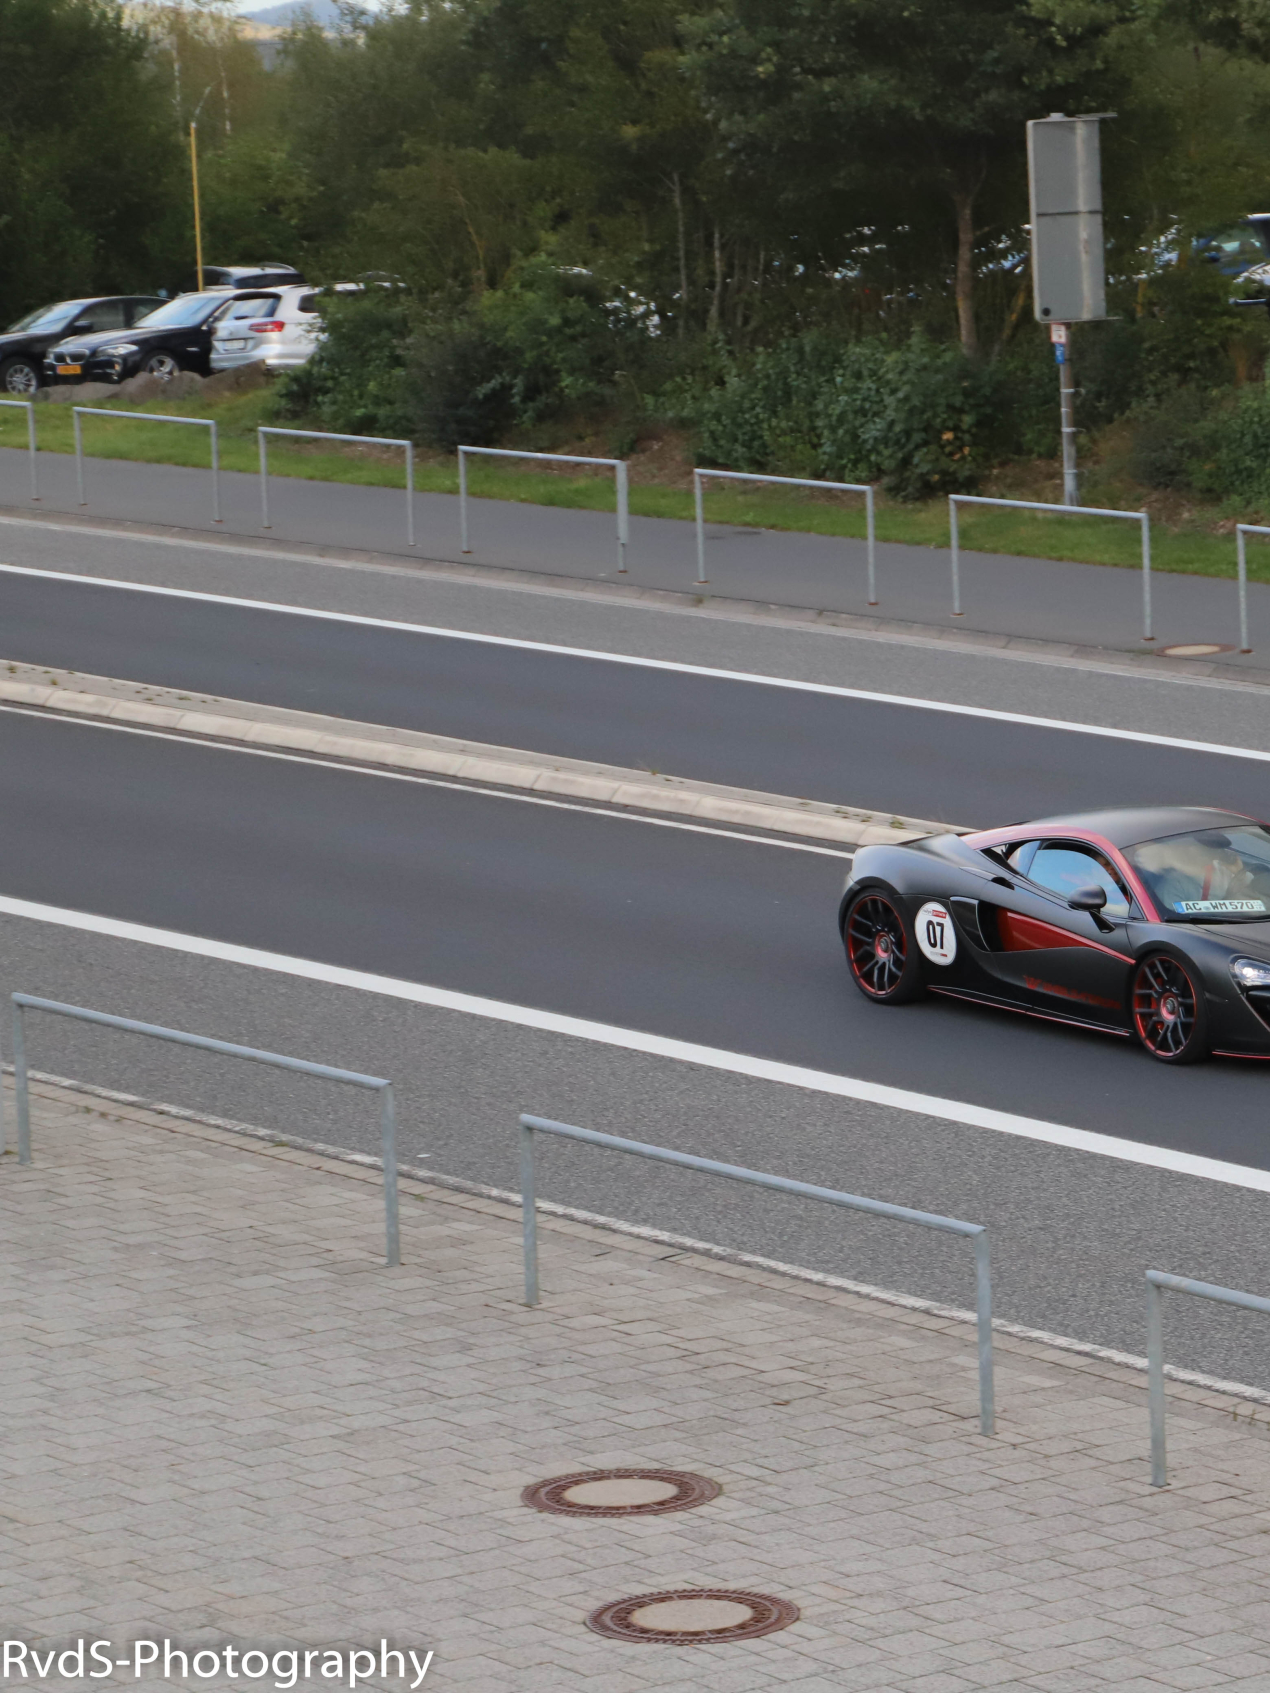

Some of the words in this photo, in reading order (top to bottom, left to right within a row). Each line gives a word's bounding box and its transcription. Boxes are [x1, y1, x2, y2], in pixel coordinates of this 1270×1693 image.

[1184, 902, 1202, 912] AC
[1209, 901, 1229, 911] WM
[1229, 901, 1255, 910] 570
[926, 919, 945, 950] 07
